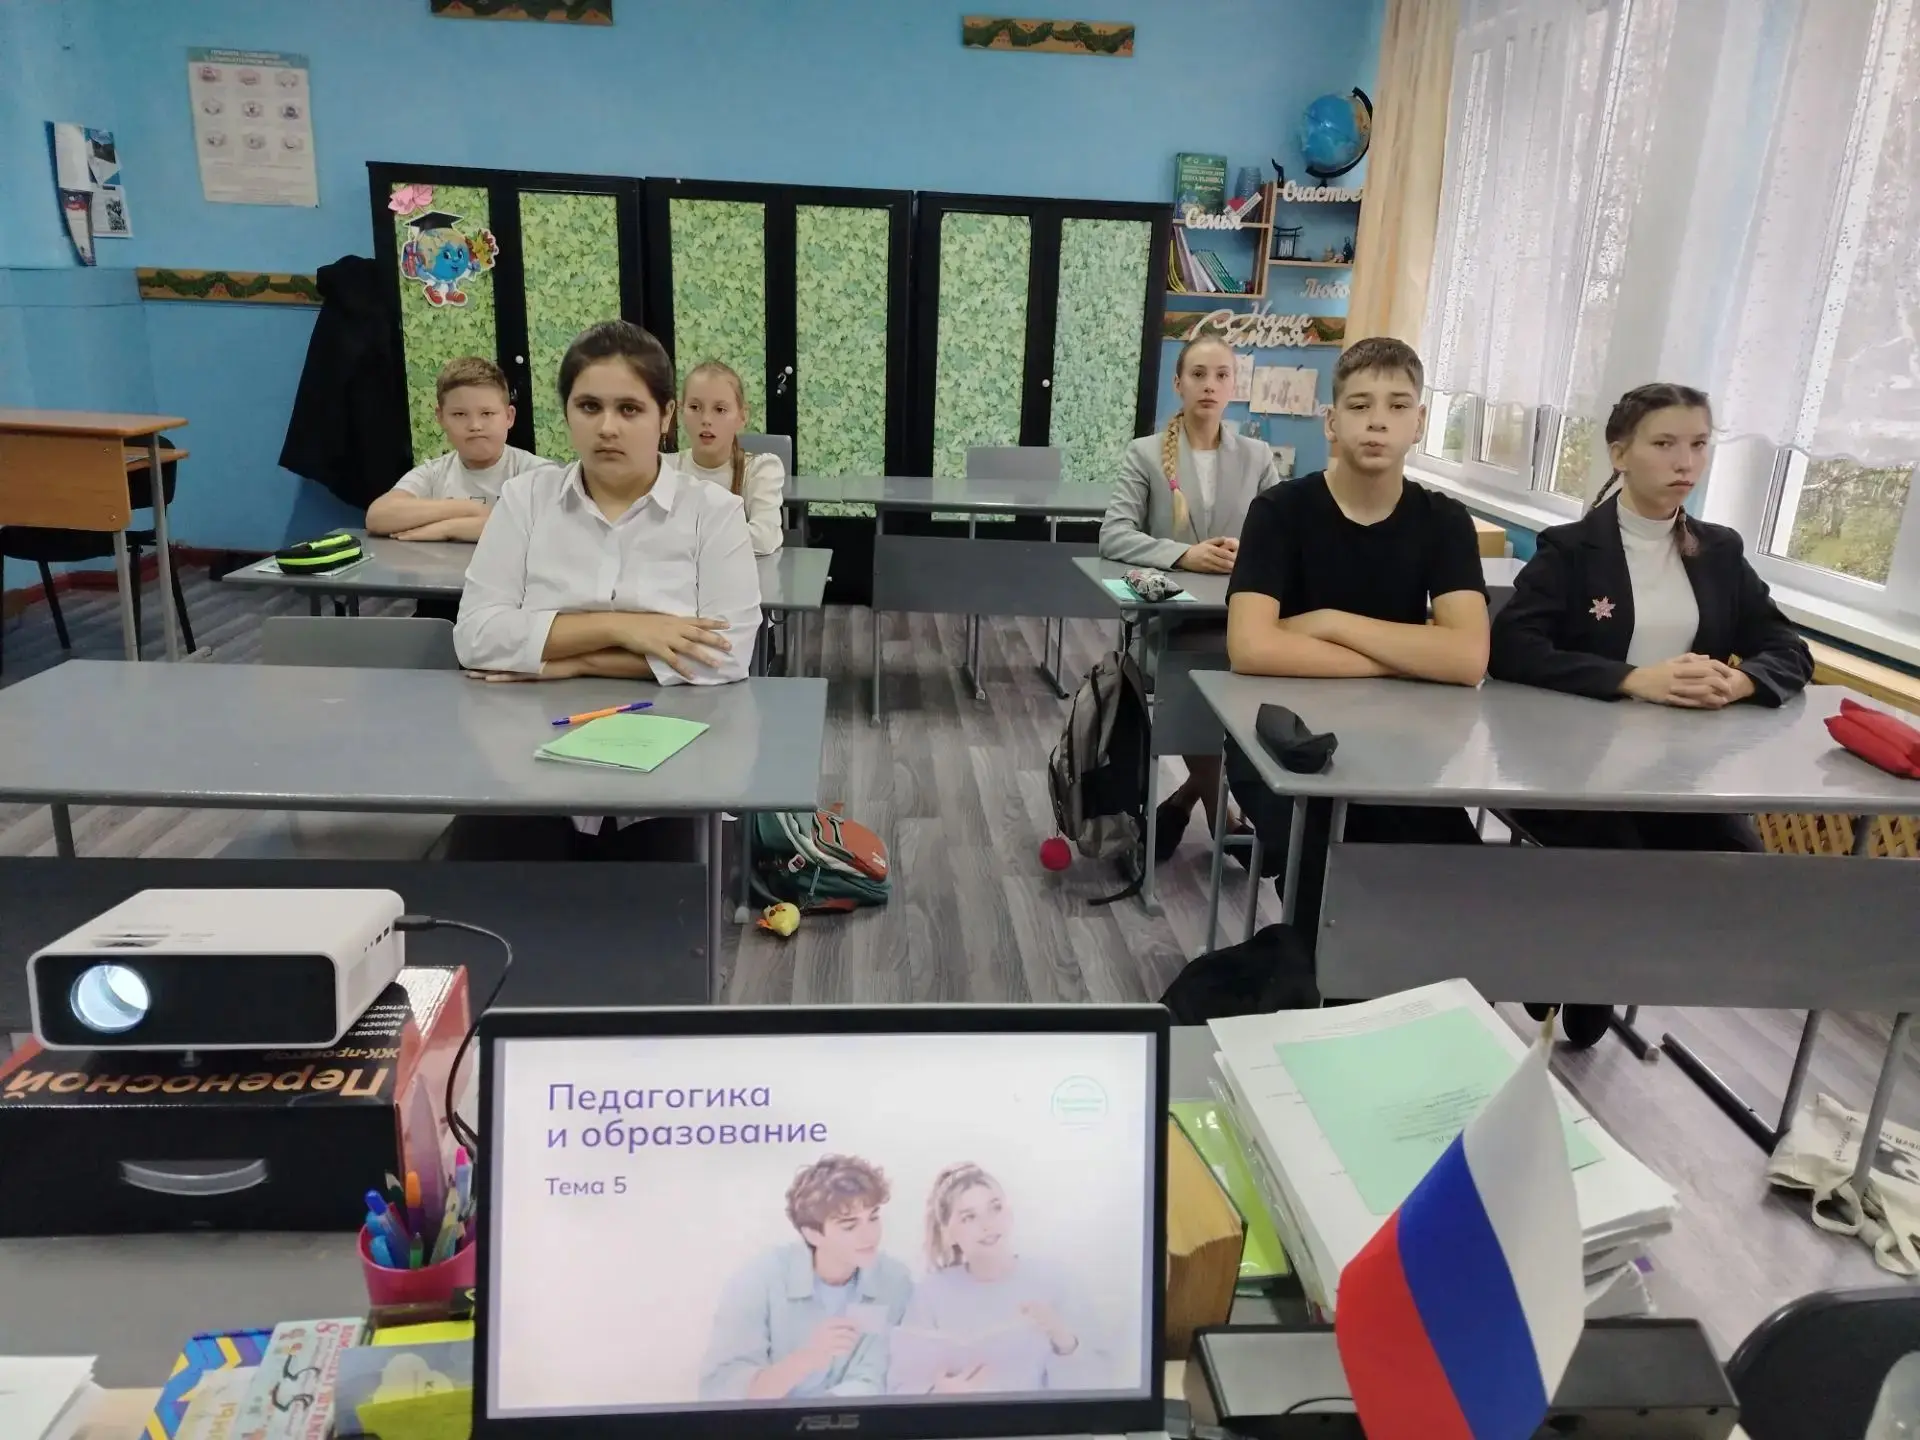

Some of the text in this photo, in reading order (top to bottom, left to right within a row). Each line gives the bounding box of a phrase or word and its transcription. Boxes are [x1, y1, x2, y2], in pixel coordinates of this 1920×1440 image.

[1283, 180, 1363, 202] Счастье
[1185, 207, 1244, 230] Семья
[1303, 278, 1351, 298] Любо
[1248, 300, 1314, 329] Наша
[3, 1064, 390, 1099] Переносной
[549, 1084, 771, 1114] Педагогика
[547, 1119, 828, 1153] и образование
[545, 1176, 627, 1195] Тема 5
[796, 1413, 860, 1432] ASUS
